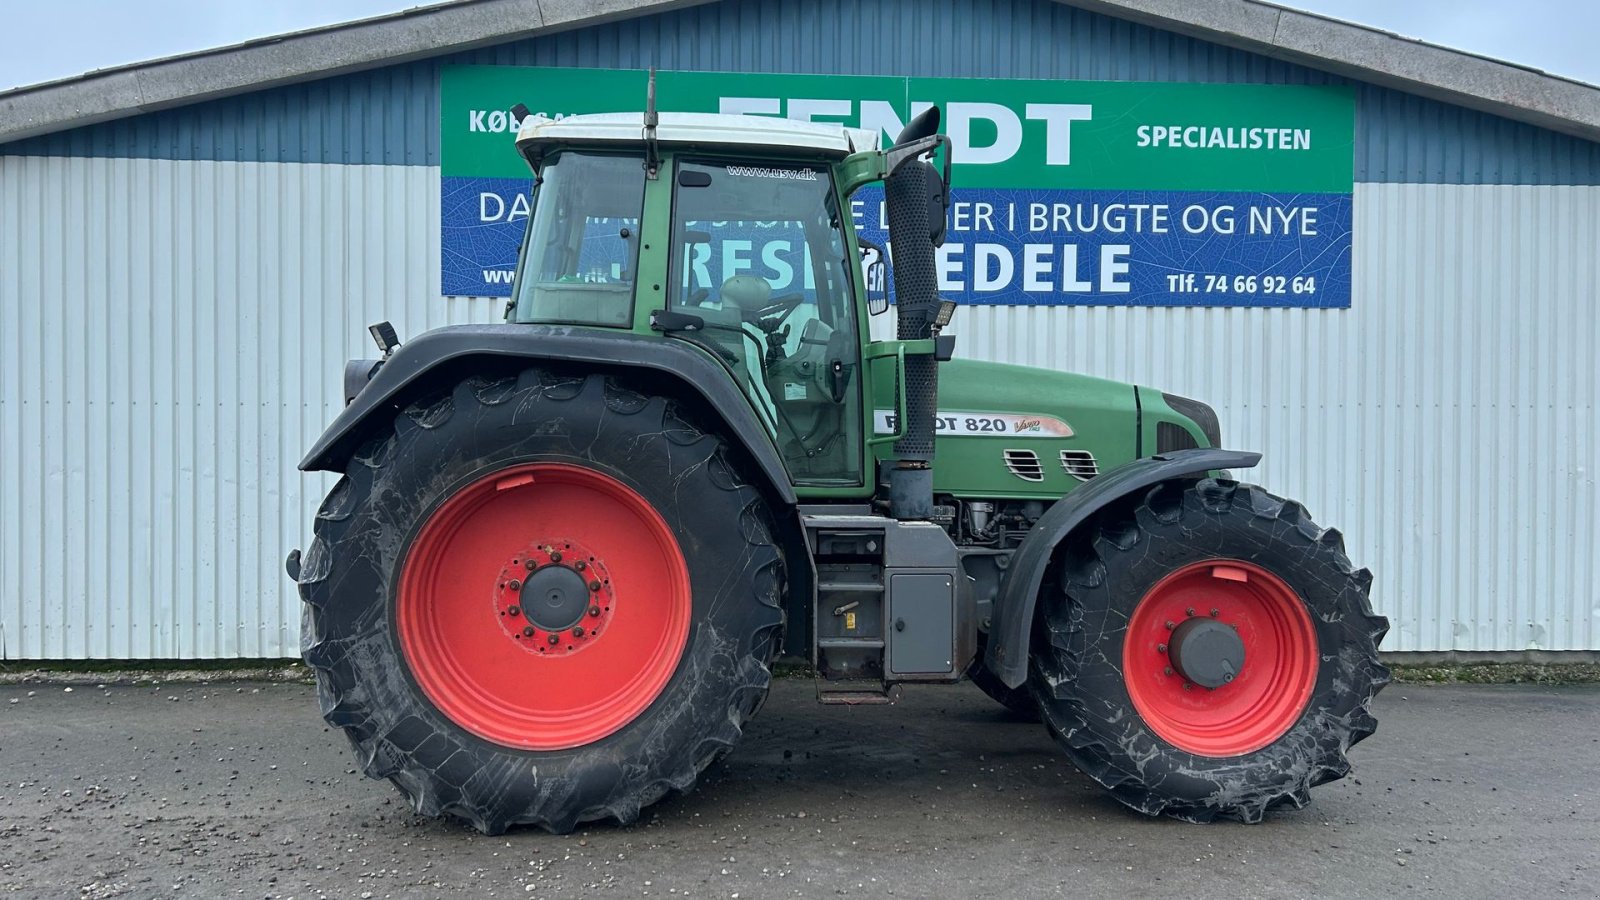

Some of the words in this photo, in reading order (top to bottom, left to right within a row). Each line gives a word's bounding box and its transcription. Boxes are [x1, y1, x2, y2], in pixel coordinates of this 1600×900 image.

[1136, 125, 1311, 150] SPECIALISTEN
[726, 165, 817, 181] www.usv.dk
[1008, 202, 1015, 232] I
[1029, 203, 1169, 233] BRUGTE
[1181, 205, 1235, 234] OG
[1249, 206, 1318, 236] NYE
[1166, 273, 1199, 293] Tlf.
[1204, 275, 1228, 293] 74
[1233, 275, 1257, 294] 66
[1263, 275, 1286, 294] 92
[1291, 276, 1316, 294] 64
[965, 418, 1007, 432] 820
